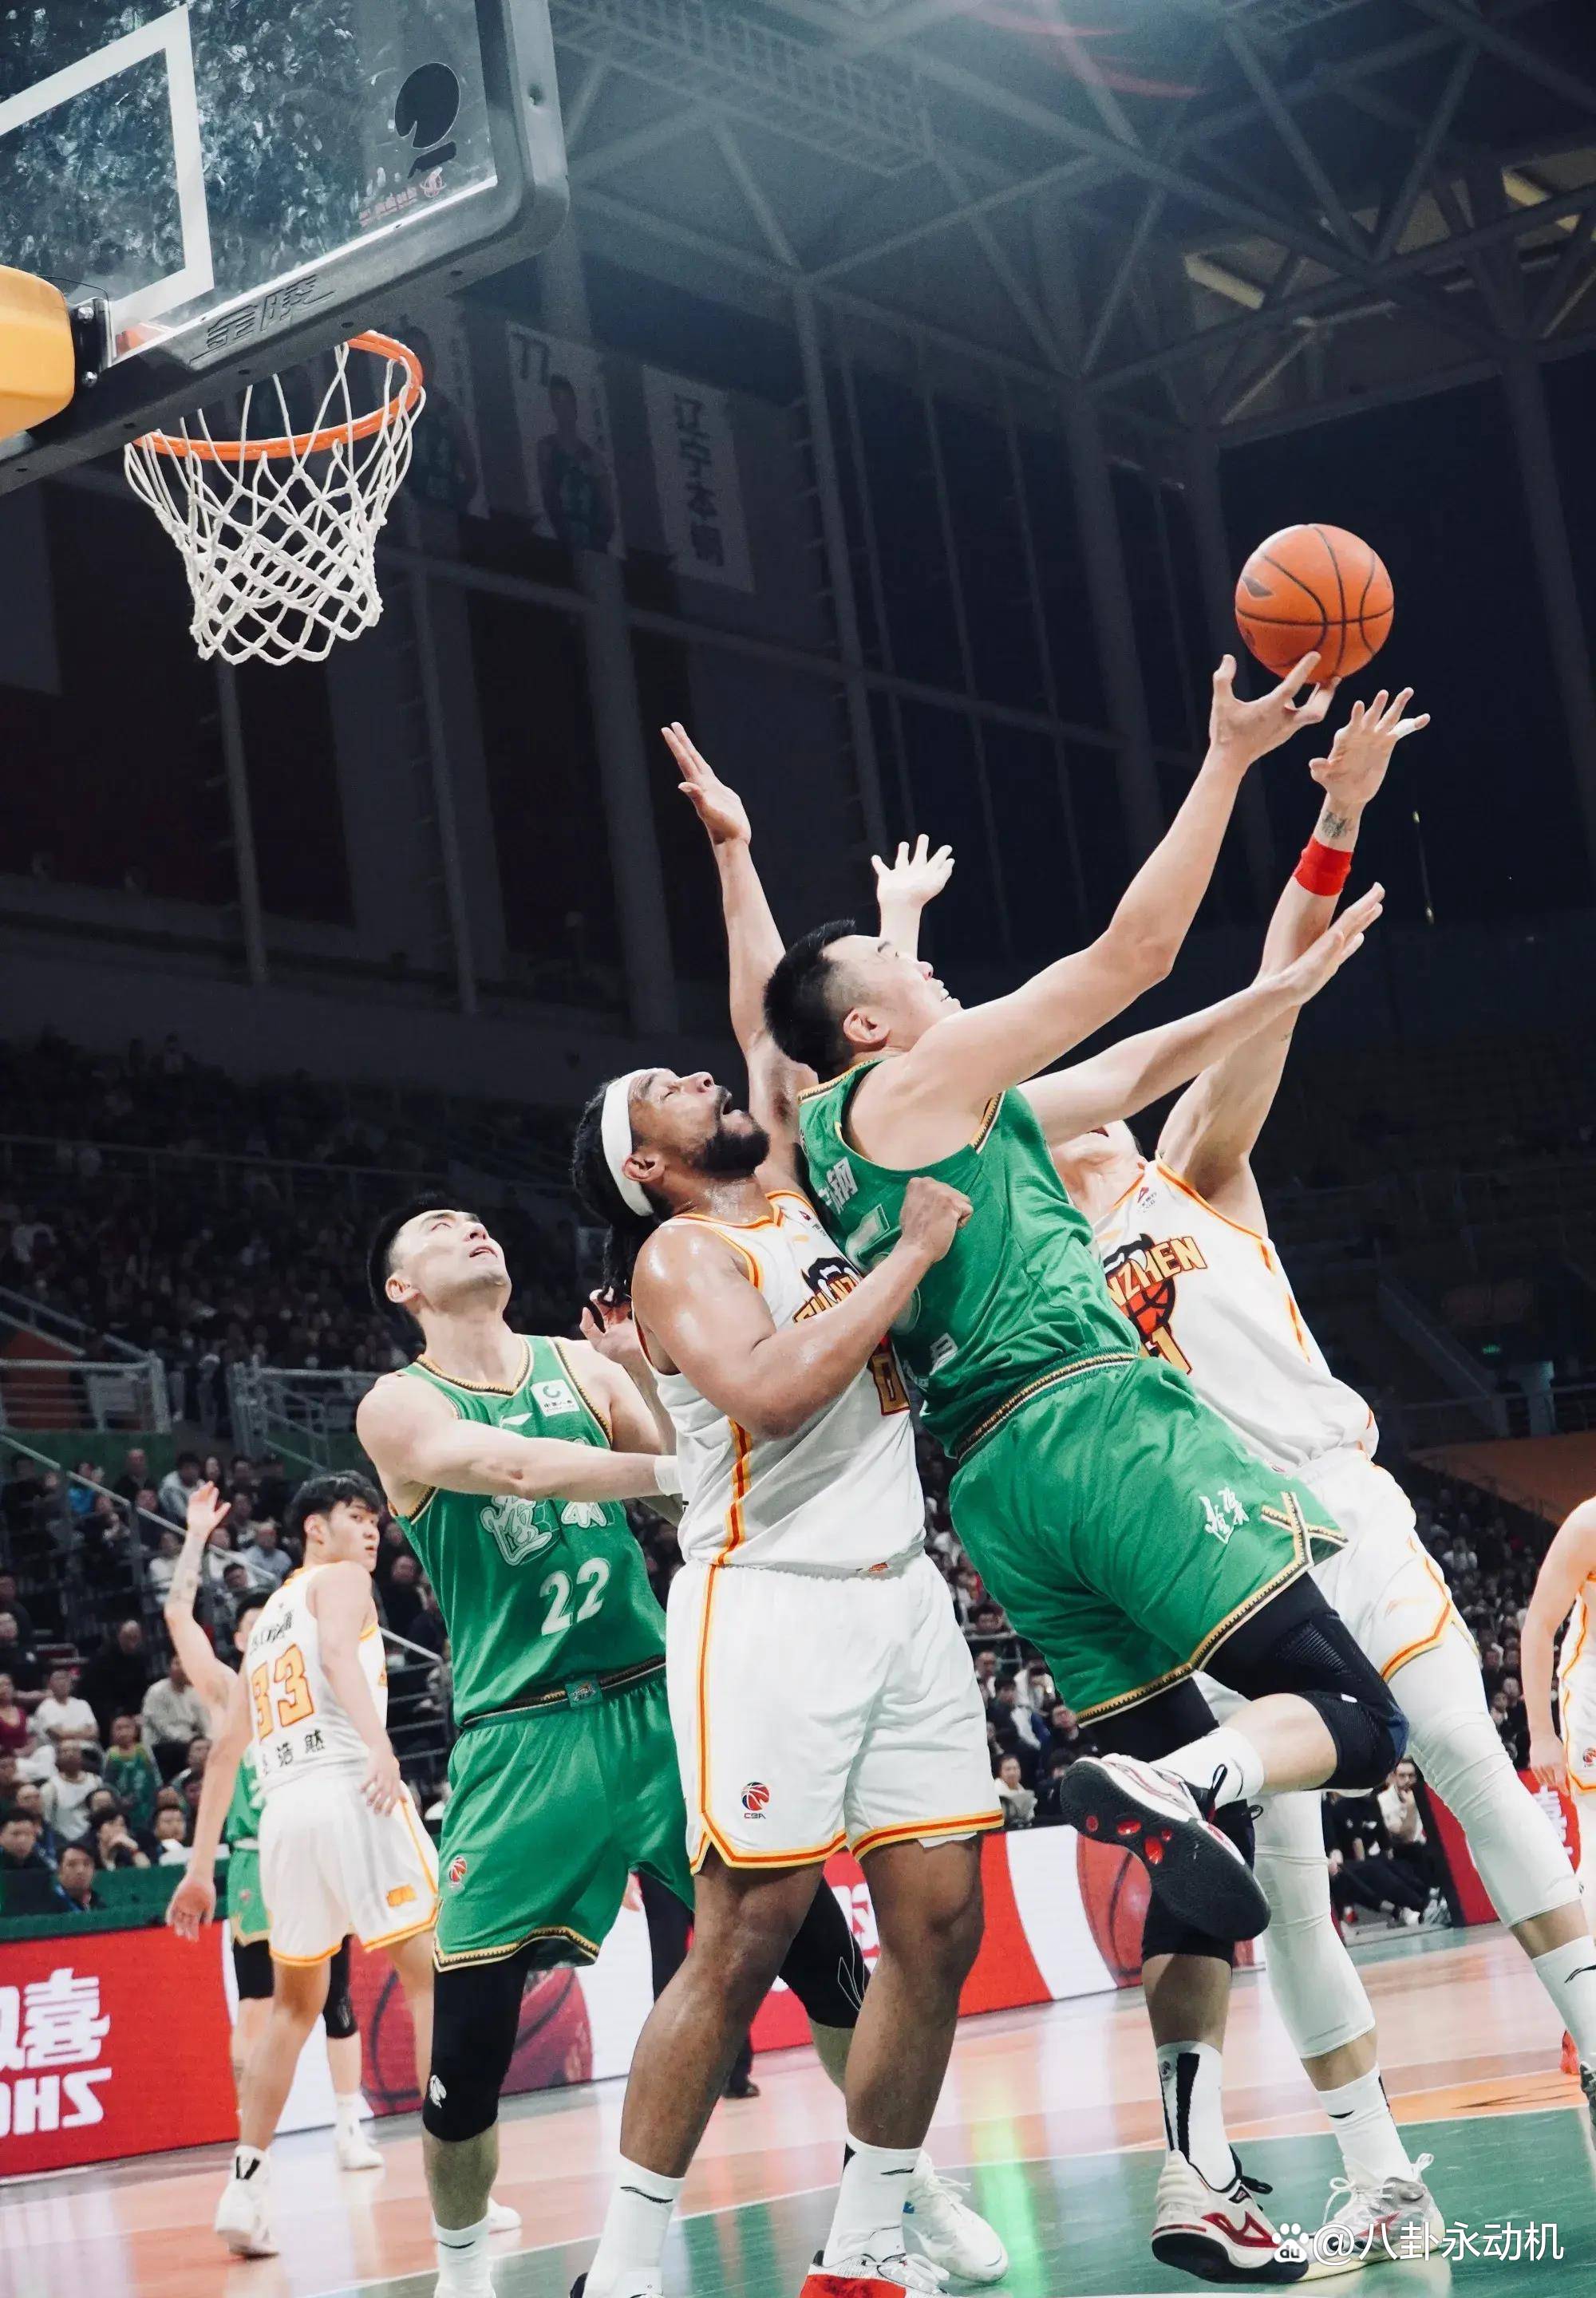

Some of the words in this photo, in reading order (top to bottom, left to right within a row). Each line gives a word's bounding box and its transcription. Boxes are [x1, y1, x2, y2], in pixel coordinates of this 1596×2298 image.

[539, 1558, 614, 1637] 22
[251, 1644, 315, 1743] 33
[262, 1728, 326, 1775] 浩然
